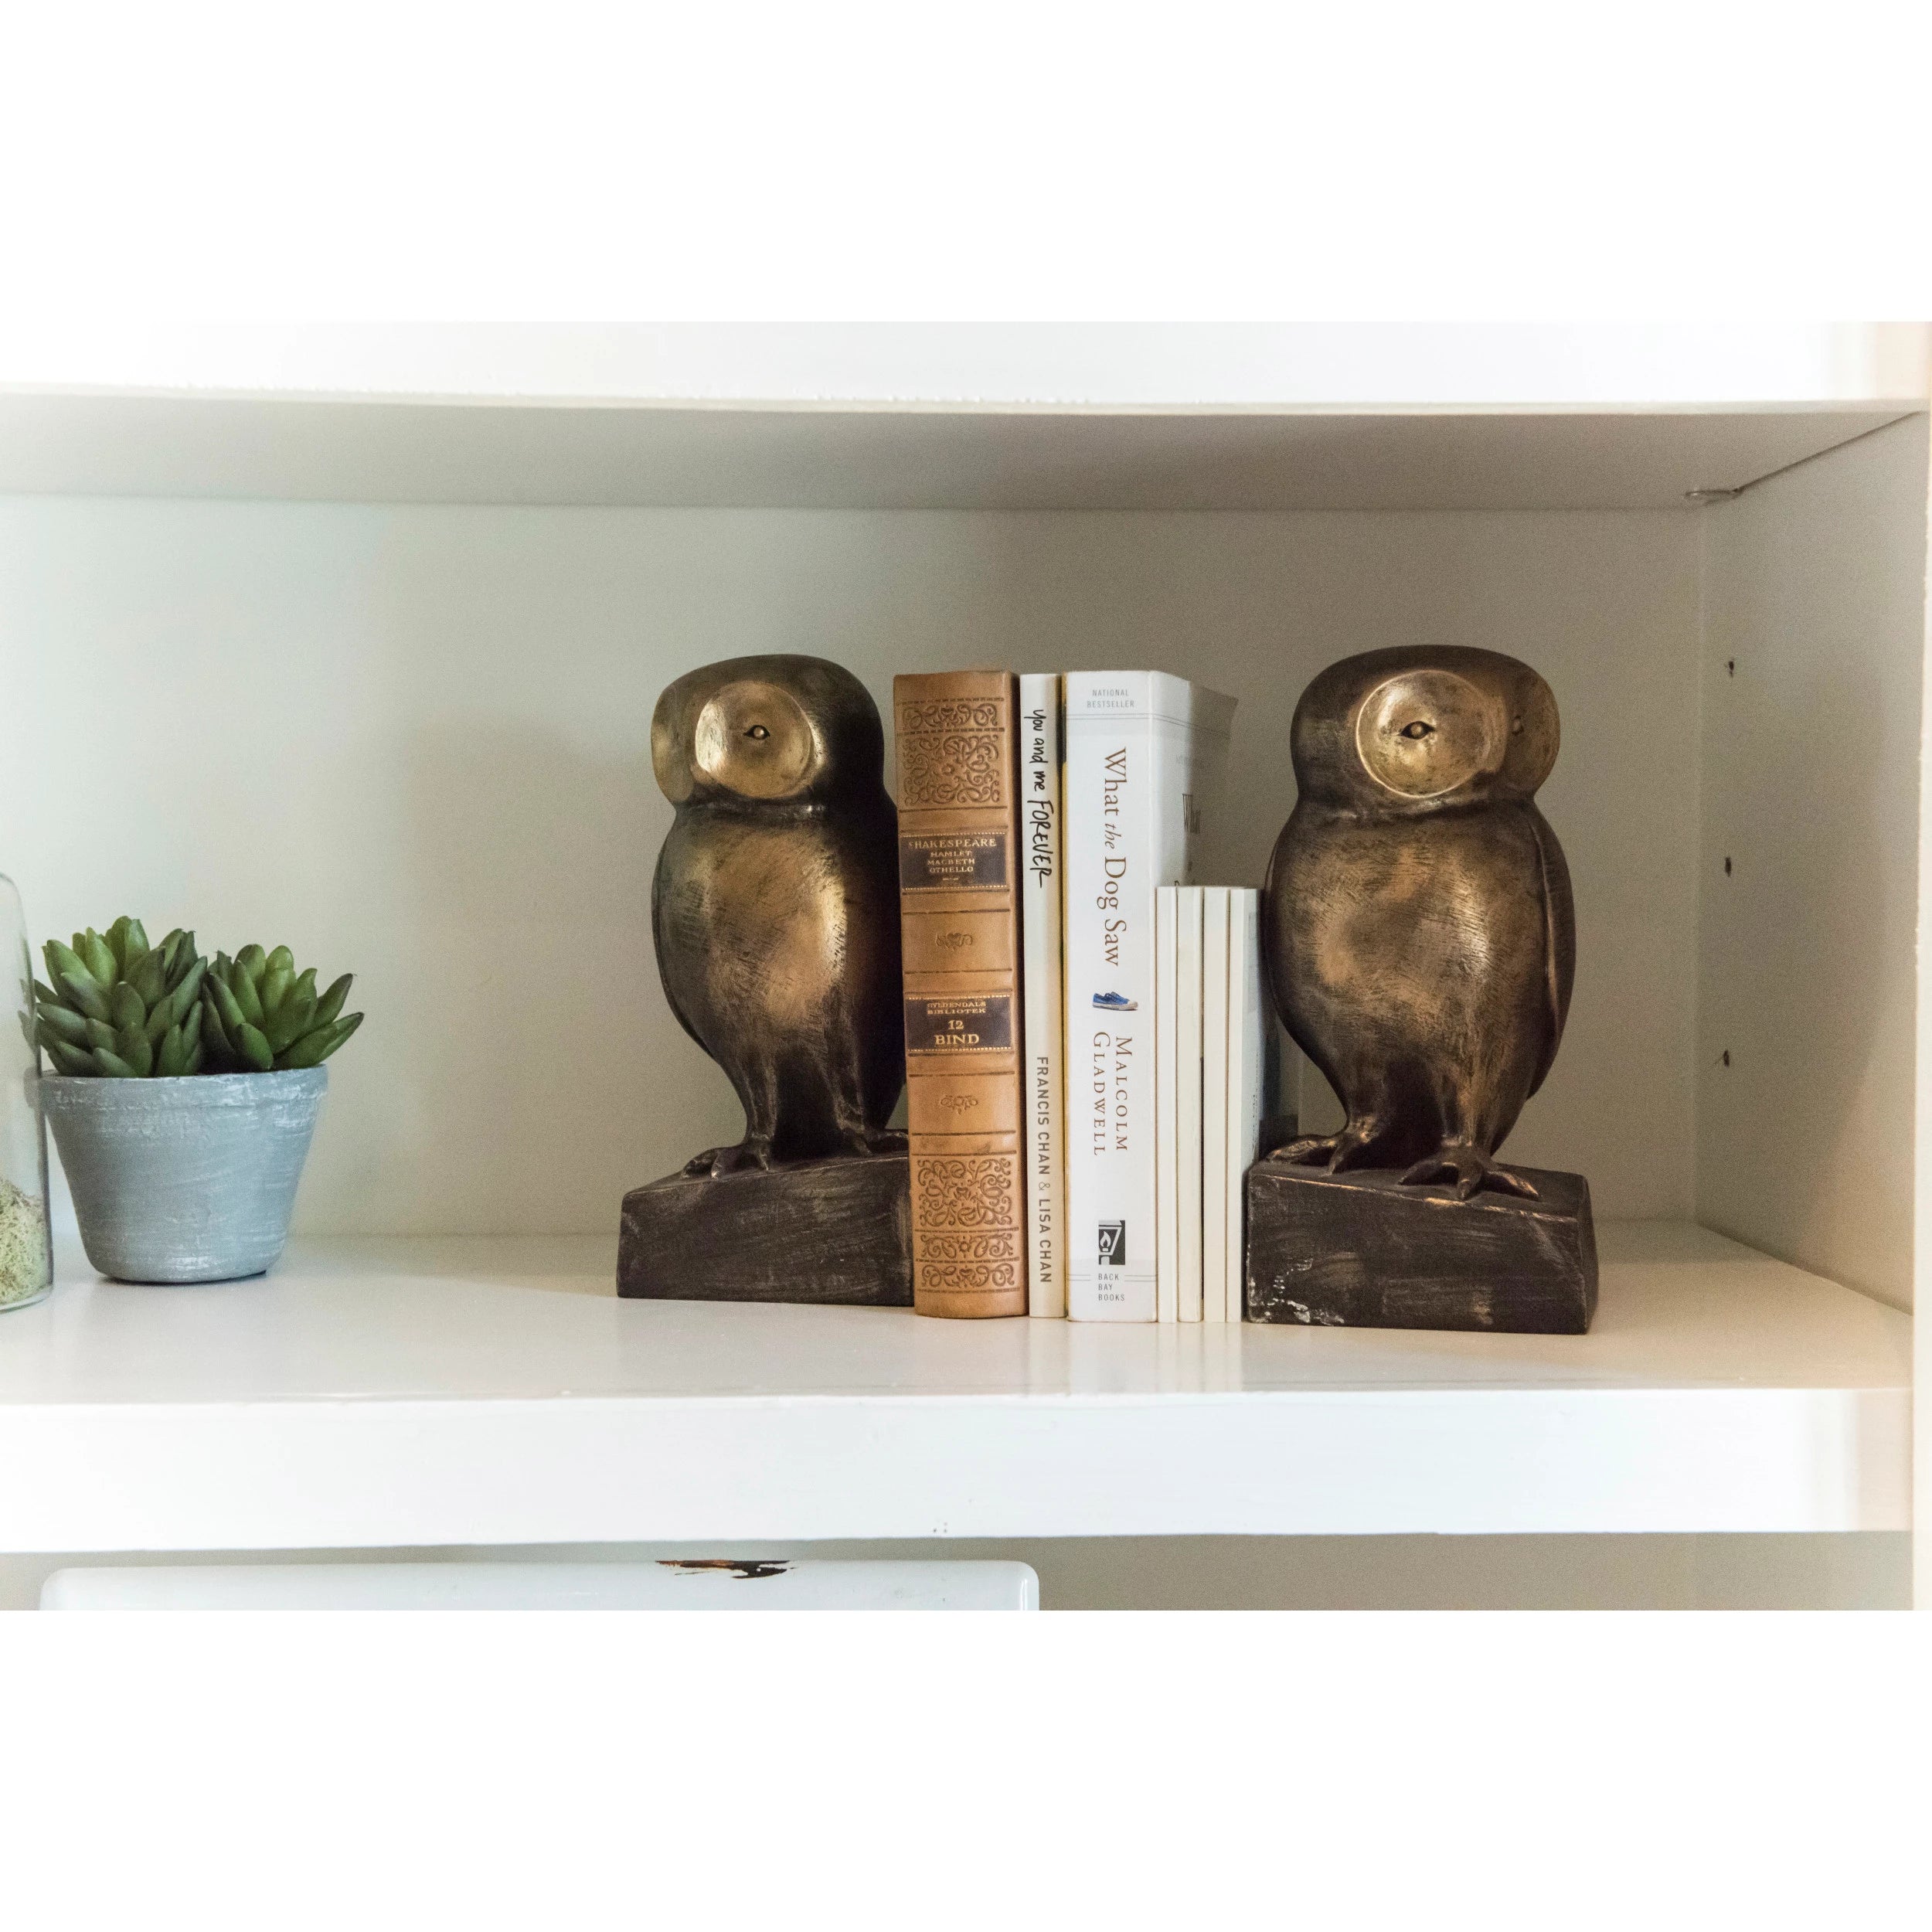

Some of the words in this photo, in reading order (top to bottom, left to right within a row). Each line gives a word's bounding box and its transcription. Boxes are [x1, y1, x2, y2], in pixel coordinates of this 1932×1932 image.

[1087, 699, 1134, 708] BESTSELLER
[1029, 737, 1049, 764] and
[1033, 771, 1046, 792] me
[1104, 747, 1128, 815] What
[1027, 800, 1054, 888] FOREVER
[1104, 822, 1122, 849] the
[1097, 856, 1127, 910] Dog
[1104, 919, 1127, 967] Saw
[935, 1034, 980, 1045] BIND
[947, 1020, 964, 1030] 12
[1036, 1056, 1049, 1126] FRANCIS
[1093, 1032, 1111, 1156] GLADWELL
[1115, 1036, 1133, 1151] MALCOLM
[1037, 1131, 1050, 1175] CHAN
[1038, 1181, 1050, 1192] &
[1039, 1199, 1051, 1234] LISA
[1039, 1240, 1052, 1284] CHAN
[1098, 1294, 1125, 1302] BOOKS
